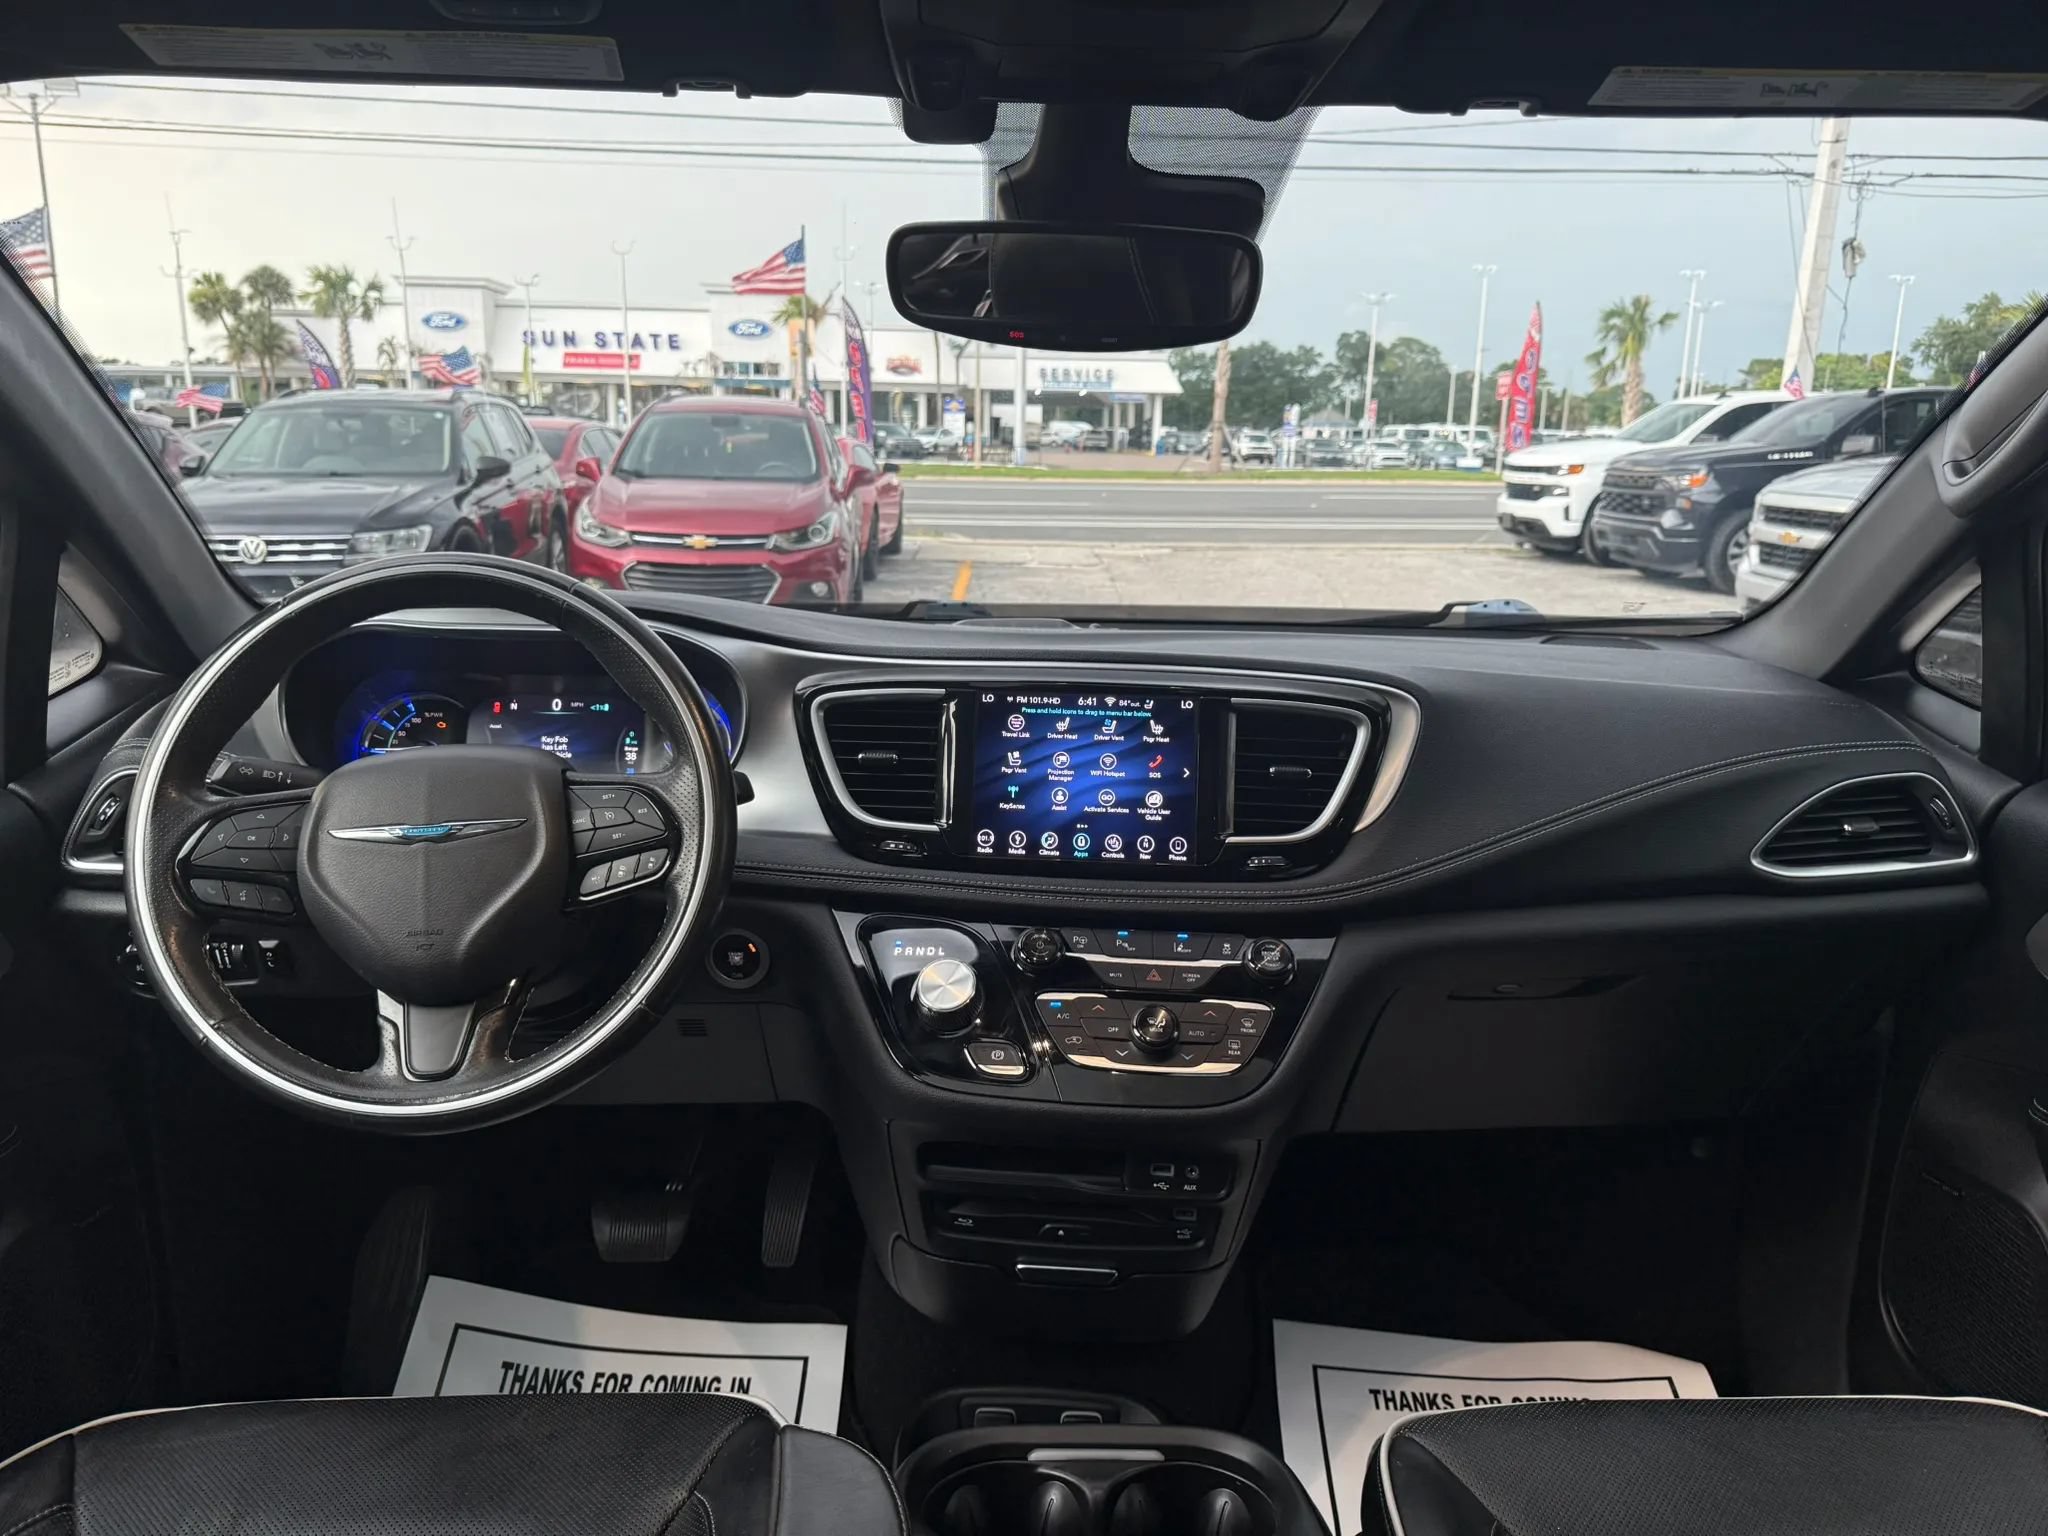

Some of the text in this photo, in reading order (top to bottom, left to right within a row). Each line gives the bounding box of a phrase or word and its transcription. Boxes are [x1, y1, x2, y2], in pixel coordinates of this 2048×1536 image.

[428, 315, 460, 328] Ford
[734, 322, 764, 337] Ford
[1009, 331, 1025, 339] SOS
[523, 330, 681, 350] SUN STATE
[1040, 368, 1114, 380] SERVICE
[982, 694, 994, 703] LO
[1016, 696, 1061, 705] FM 101.9-HD
[1078, 697, 1098, 706] 6:41
[551, 698, 562, 711] 0
[1181, 701, 1194, 709] LO
[1084, 709, 1098, 718] drag
[541, 735, 569, 744] Key Fob
[1047, 732, 1063, 740] Driver
[541, 743, 568, 751] has Left
[625, 752, 637, 761] 38
[1047, 768, 1075, 776] Projection
[1083, 806, 1107, 814] Activate
[977, 846, 993, 854] Radio
[1039, 849, 1060, 857] Climate
[1073, 850, 1089, 858] Apps
[1168, 854, 1187, 862] Phone
[500, 1360, 585, 1394] THANKS
[592, 1371, 633, 1394] FOR
[1368, 1388, 1454, 1412] THANKS
